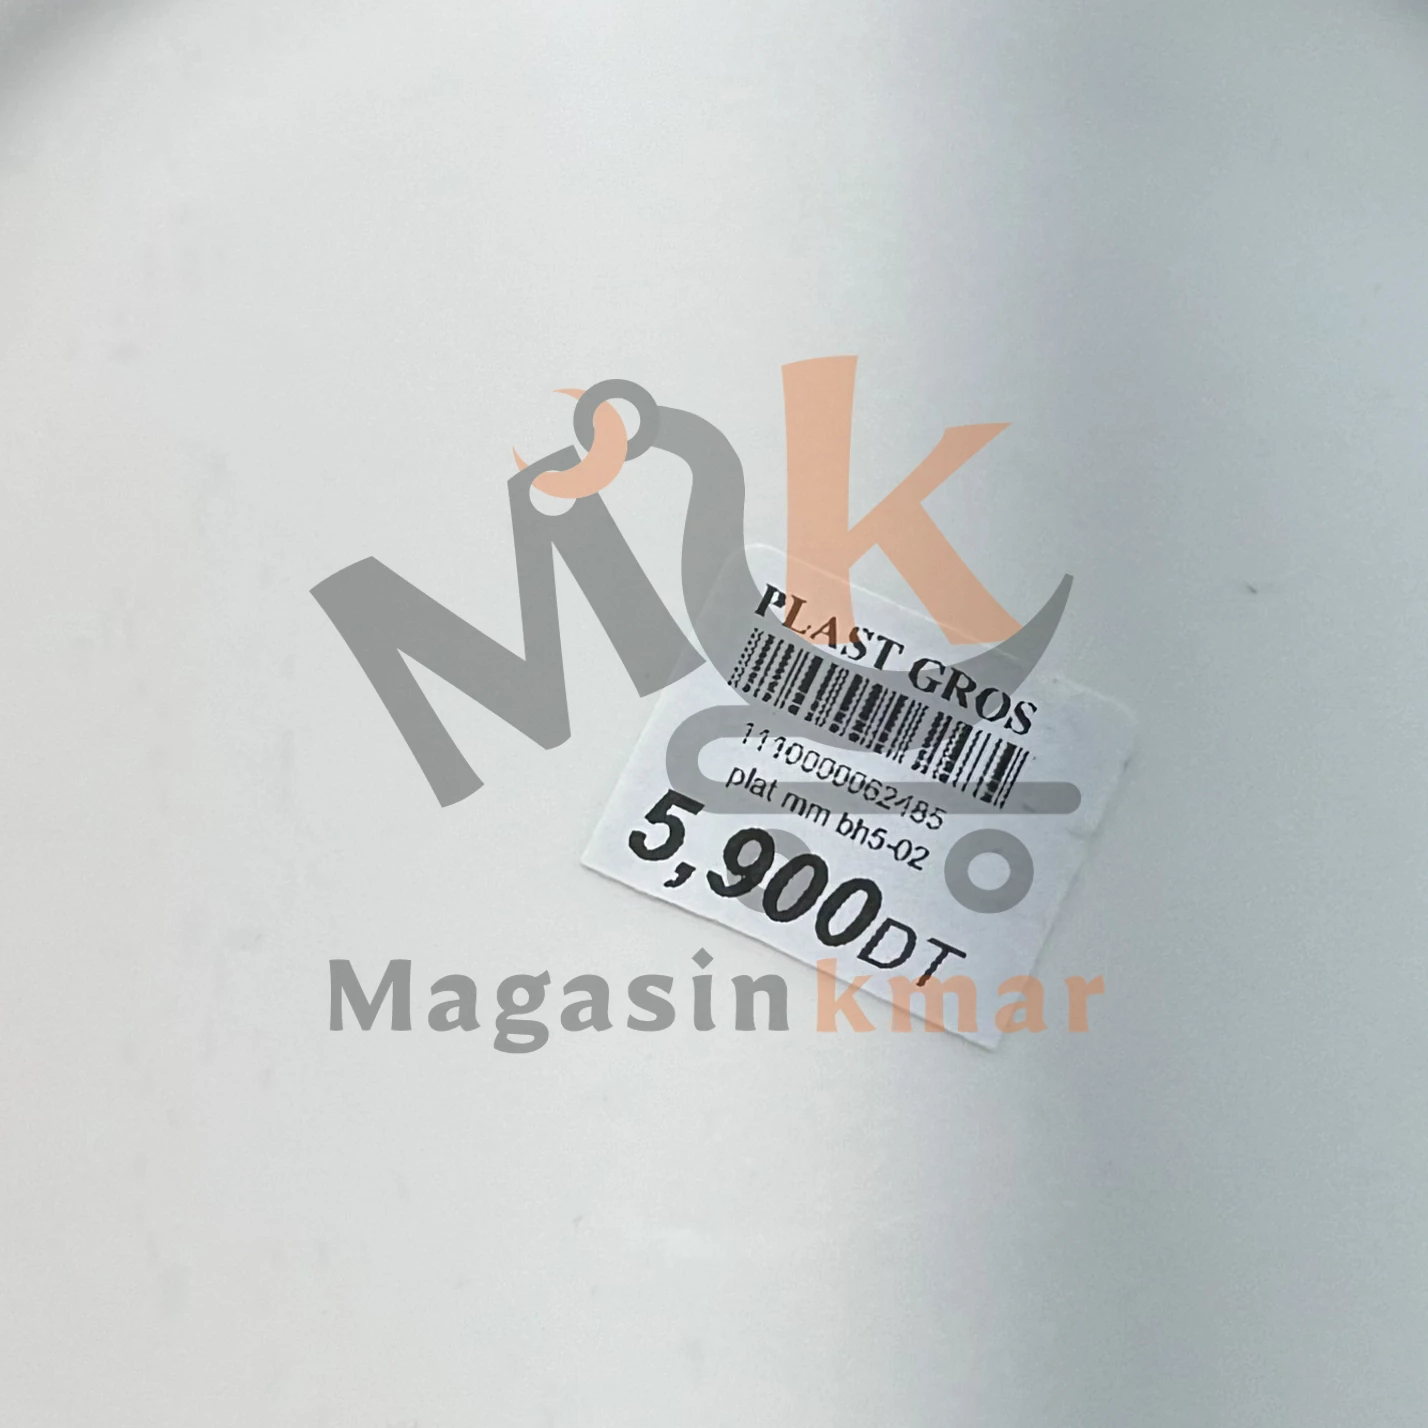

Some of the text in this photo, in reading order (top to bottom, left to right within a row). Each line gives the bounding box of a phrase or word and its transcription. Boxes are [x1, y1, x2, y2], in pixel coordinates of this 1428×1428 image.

[754, 584, 1037, 735] PLAST GROS
[726, 764, 931, 871] plat mm bh5-02
